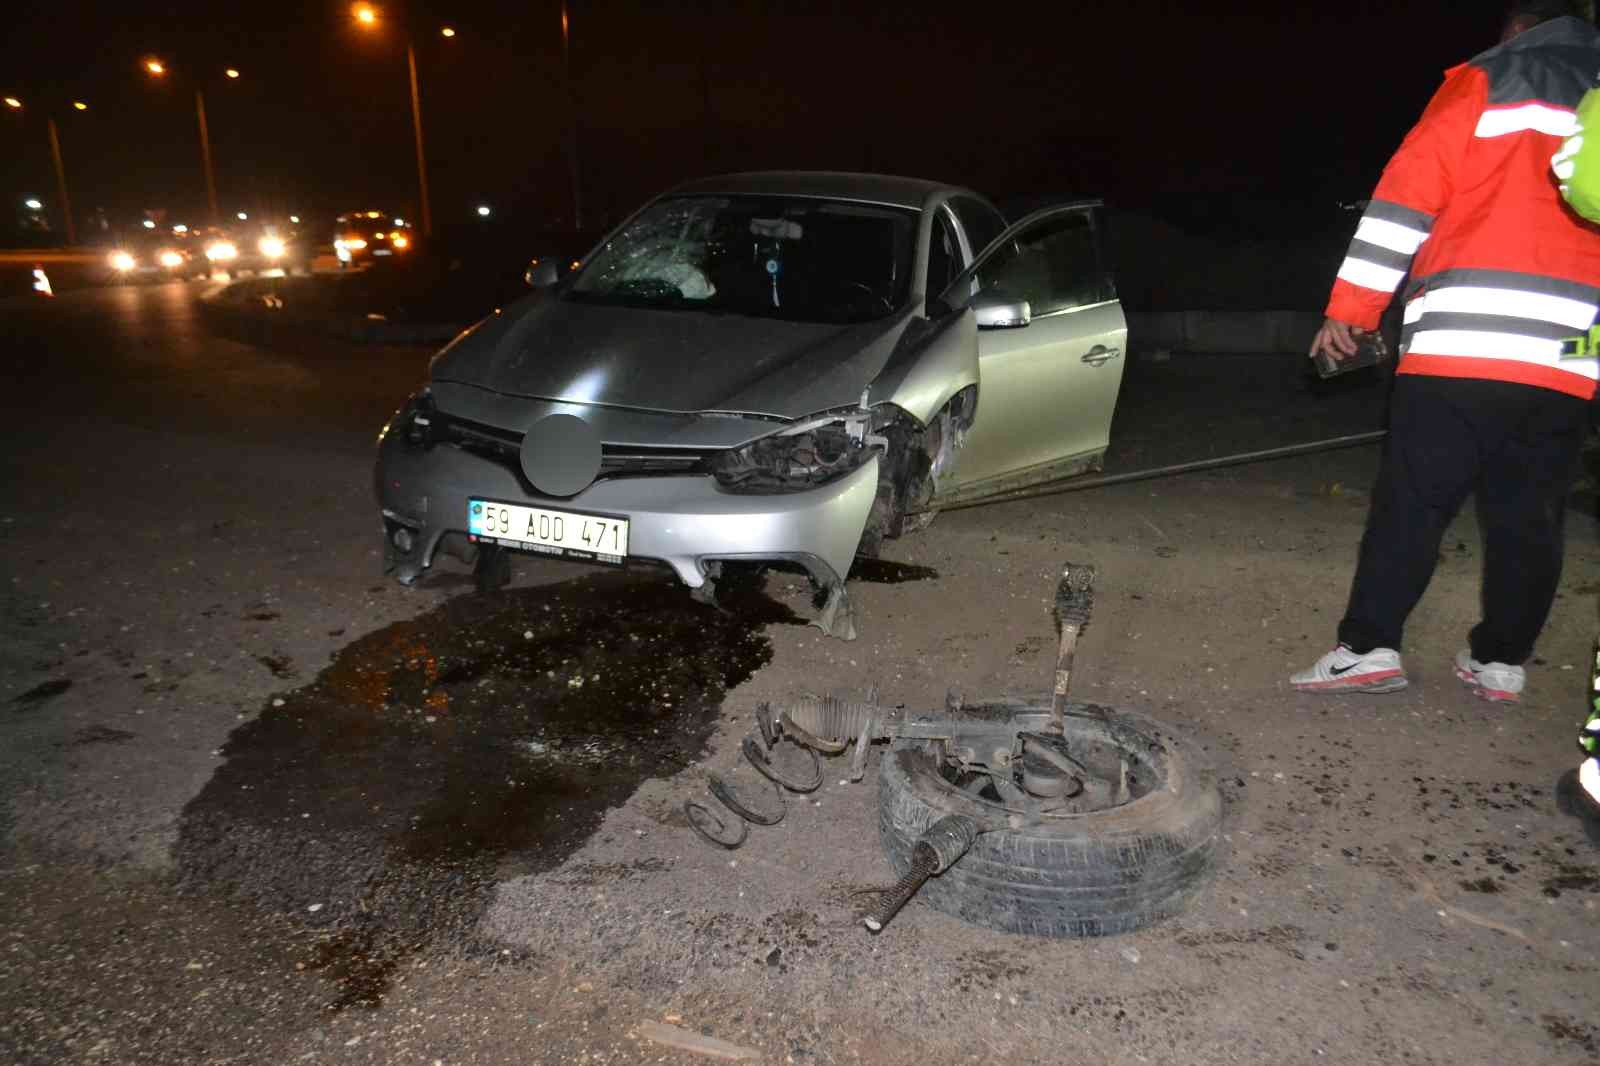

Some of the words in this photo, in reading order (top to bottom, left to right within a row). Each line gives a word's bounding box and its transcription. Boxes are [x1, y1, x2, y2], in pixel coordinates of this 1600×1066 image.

[486, 506, 509, 534] 59
[526, 512, 564, 542] ADD
[581, 519, 619, 551] 471
